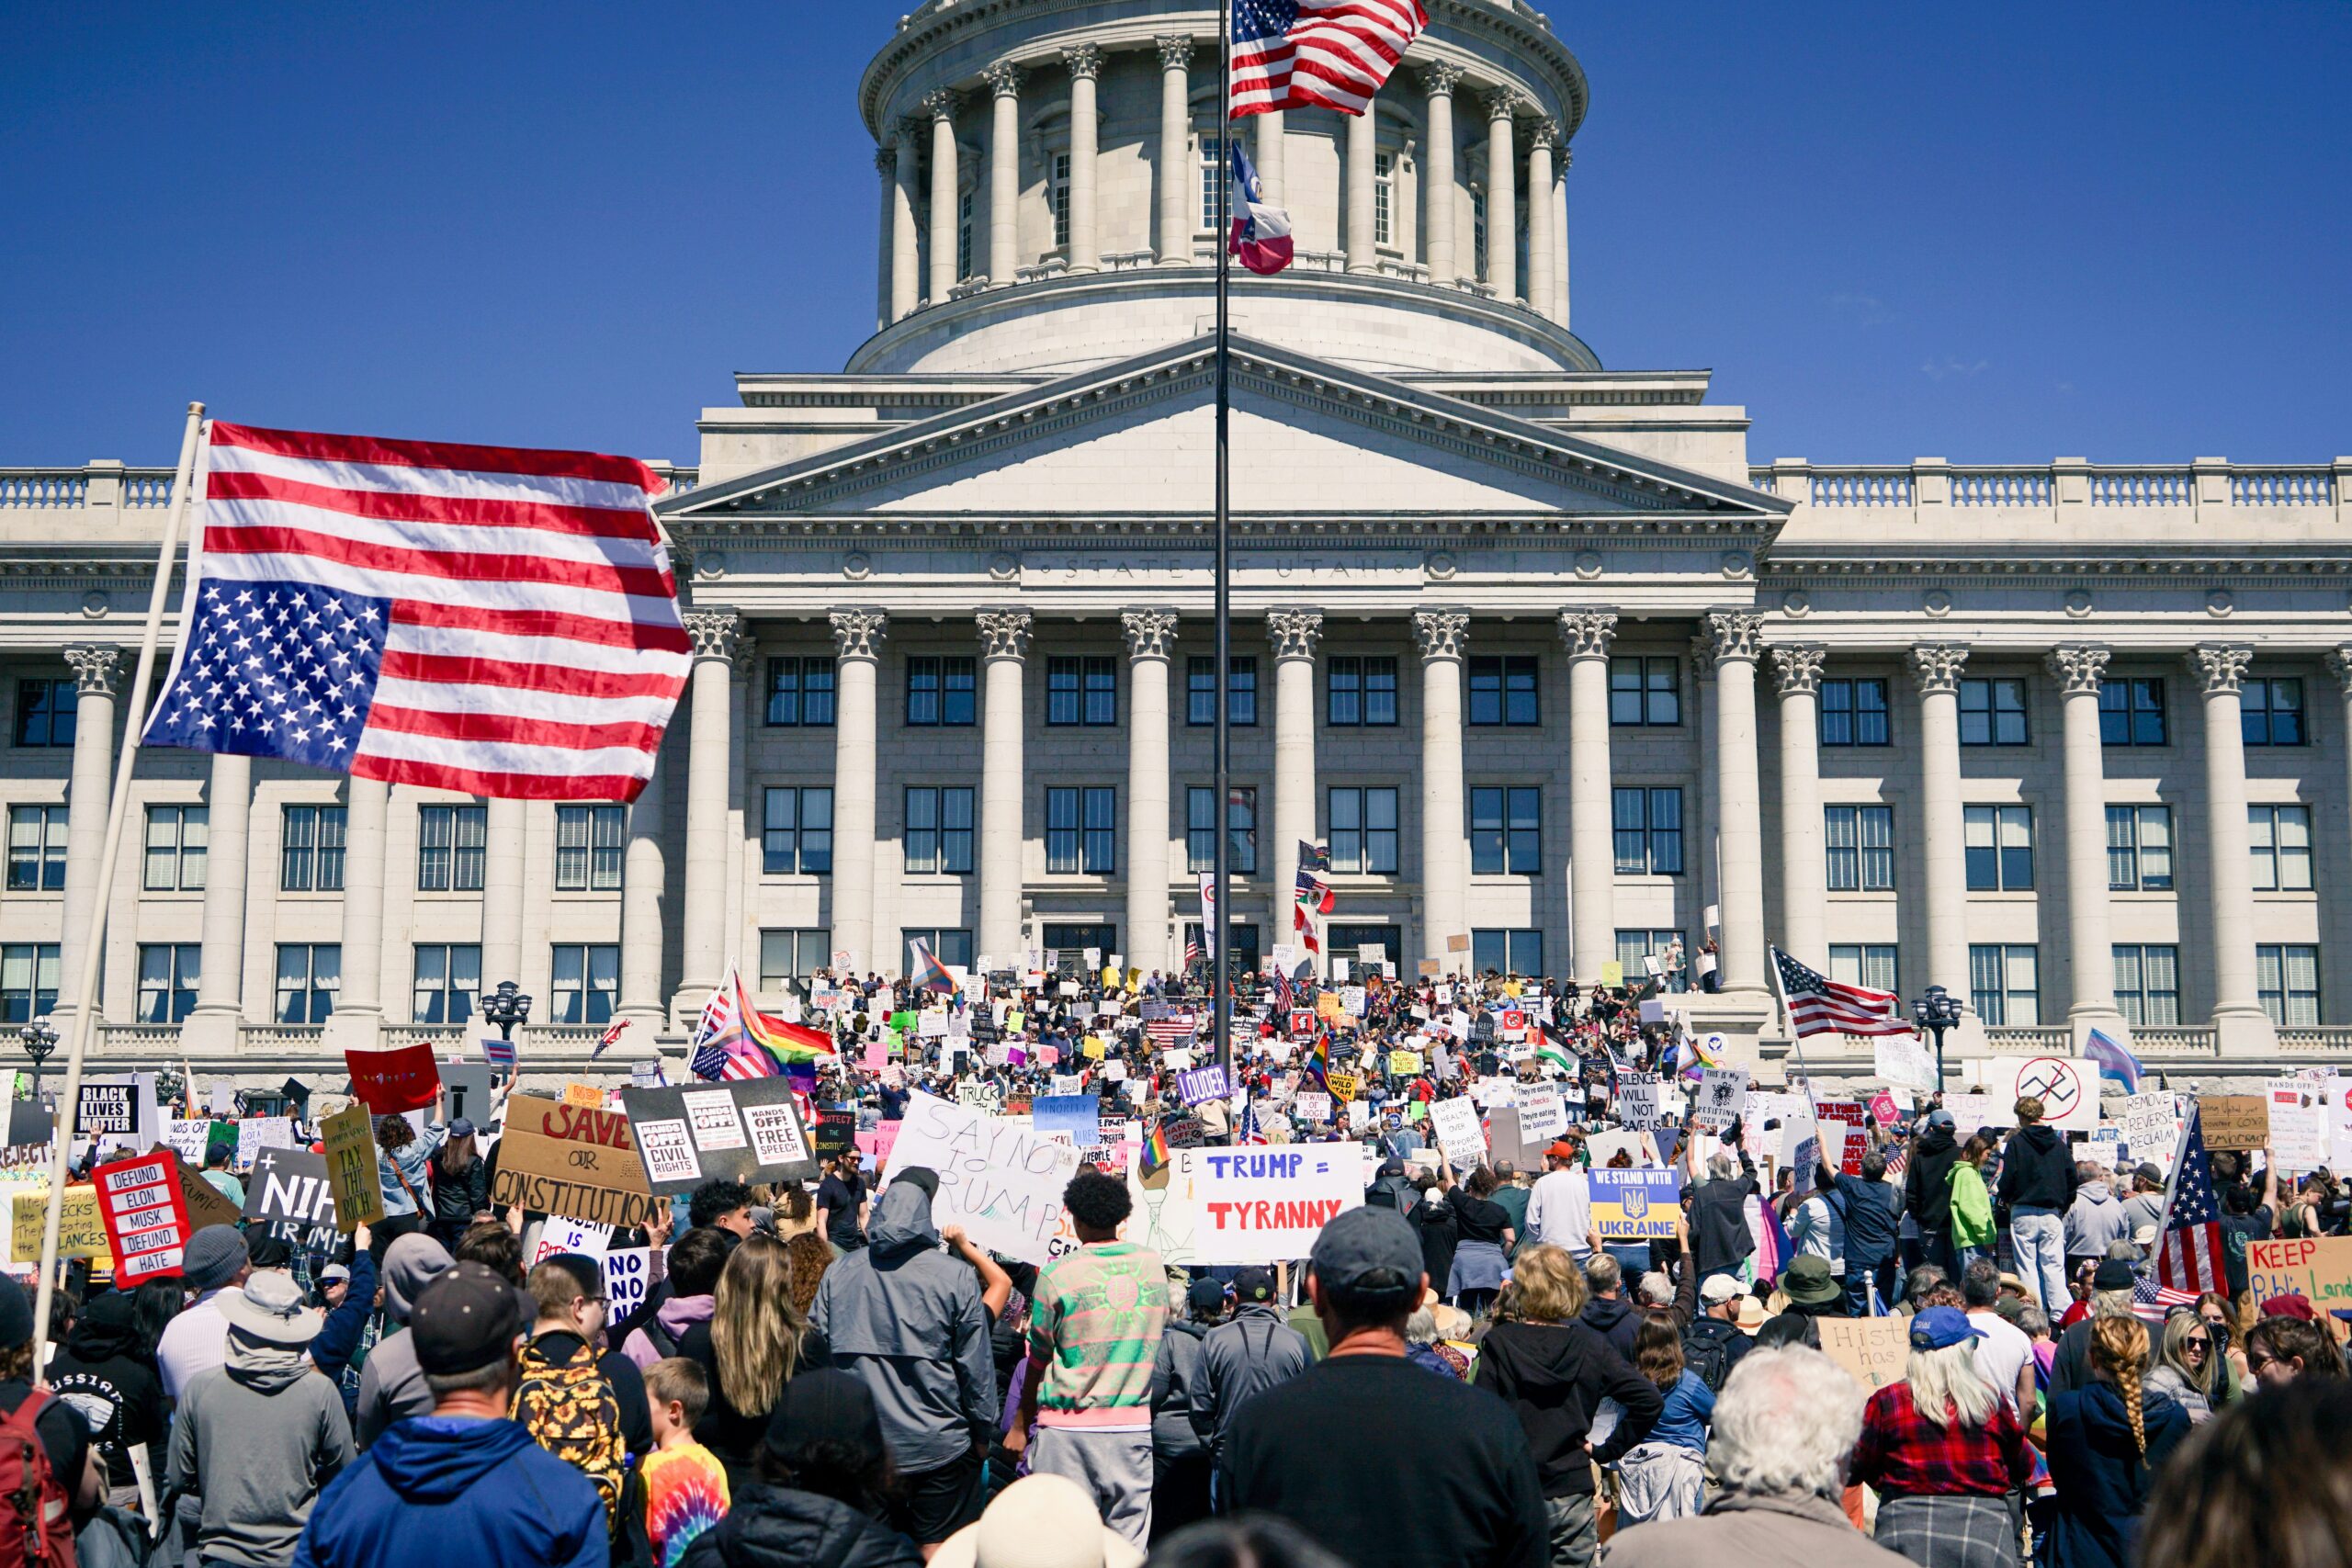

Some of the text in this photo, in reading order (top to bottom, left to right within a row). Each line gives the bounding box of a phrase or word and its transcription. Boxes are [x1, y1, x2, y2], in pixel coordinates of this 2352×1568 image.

[1066, 559, 1182, 579] STATE
[1276, 558, 1379, 579] UTAH
[1179, 1066, 1227, 1103] LOUDER
[1331, 1079, 1351, 1089] WILD
[1617, 1073, 1657, 1086] SILENCE
[2267, 1081, 2295, 1089] HANDS
[83, 1088, 128, 1101] BLACK
[960, 1087, 999, 1101] TRUCK
[1334, 1087, 1351, 1096] TAH
[1537, 1085, 1554, 1093] eating
[1622, 1089, 1649, 1101] WILL
[1298, 1093, 1330, 1101] BEWARE
[1946, 1095, 1990, 1109] STOP
[2126, 1093, 2172, 1112] REMOVE
[86, 1102, 124, 1116] LIVES
[692, 1107, 731, 1118] HANDS
[1035, 1103, 1088, 1114] MINORITY
[1434, 1100, 1465, 1114] PUBLIC
[1539, 1109, 1557, 1118] eating
[1632, 1104, 1655, 1116] NOT
[1816, 1103, 1835, 1113] THE
[752, 1109, 785, 1120] HANDS
[820, 1114, 853, 1124] ROTECT
[1440, 1111, 1470, 1123] HEALTH
[1700, 1117, 1716, 1126] ITCH
[1954, 1110, 1984, 1123] Trump
[2129, 1110, 2175, 1131] REVERSE
[80, 1118, 130, 1132] MATTER
[192, 1122, 208, 1134] OF
[543, 1104, 630, 1150] SAVE
[641, 1123, 682, 1135] HANDS
[695, 1116, 735, 1130] OFF!
[754, 1116, 789, 1128] OFF!
[1104, 1119, 1125, 1128] POWER
[1448, 1123, 1464, 1132] OVER
[1647, 1120, 1662, 1132] US
[756, 1128, 796, 1145] FREE
[919, 1104, 1005, 1161] SAY
[1441, 1131, 1484, 1146] CORPORATE
[2091, 1128, 2120, 1142] LATTER
[2131, 1129, 2176, 1150] RECLAIM
[645, 1134, 686, 1148] OFF!
[1170, 1137, 1198, 1147] OCIAL
[650, 1147, 689, 1163] CIVIL
[760, 1143, 799, 1155] SPEECH
[1087, 1149, 1110, 1162] PEOPLE
[1449, 1144, 1480, 1156] WEALTH
[337, 1144, 364, 1175] TAX
[569, 1150, 599, 1171] OUR
[655, 1160, 693, 1173] RIGHTS
[948, 1148, 988, 1173] TO
[1206, 1153, 1303, 1179] TRUMP
[1316, 1162, 1329, 1174] =
[1096, 1161, 1114, 1173] POW
[114, 1167, 158, 1189] DEFUND
[1594, 1170, 1672, 1185] WE STAND WITH
[1795, 1167, 1817, 1183] AGAI
[342, 1169, 366, 1196] THE
[126, 1189, 156, 1209] ELON
[260, 1172, 337, 1224] NIH
[492, 1169, 666, 1227] CONSTITUTION
[42, 1204, 93, 1221] CECKS
[342, 1190, 375, 1223] RICH!
[1206, 1197, 1340, 1229] TYRANNY
[130, 1210, 164, 1230] MUSK
[1598, 1220, 1676, 1235] UKRAINE
[41, 1233, 107, 1250] LANCES
[128, 1229, 172, 1252] DEFUND
[270, 1221, 348, 1255] RMP
[567, 1232, 583, 1247] IS
[2252, 1240, 2315, 1269] KEEP
[139, 1252, 169, 1272] HATE
[609, 1255, 641, 1276] NO
[611, 1278, 643, 1300] NO
[1833, 1321, 1907, 1348] Hist
[1858, 1347, 1896, 1365] has
